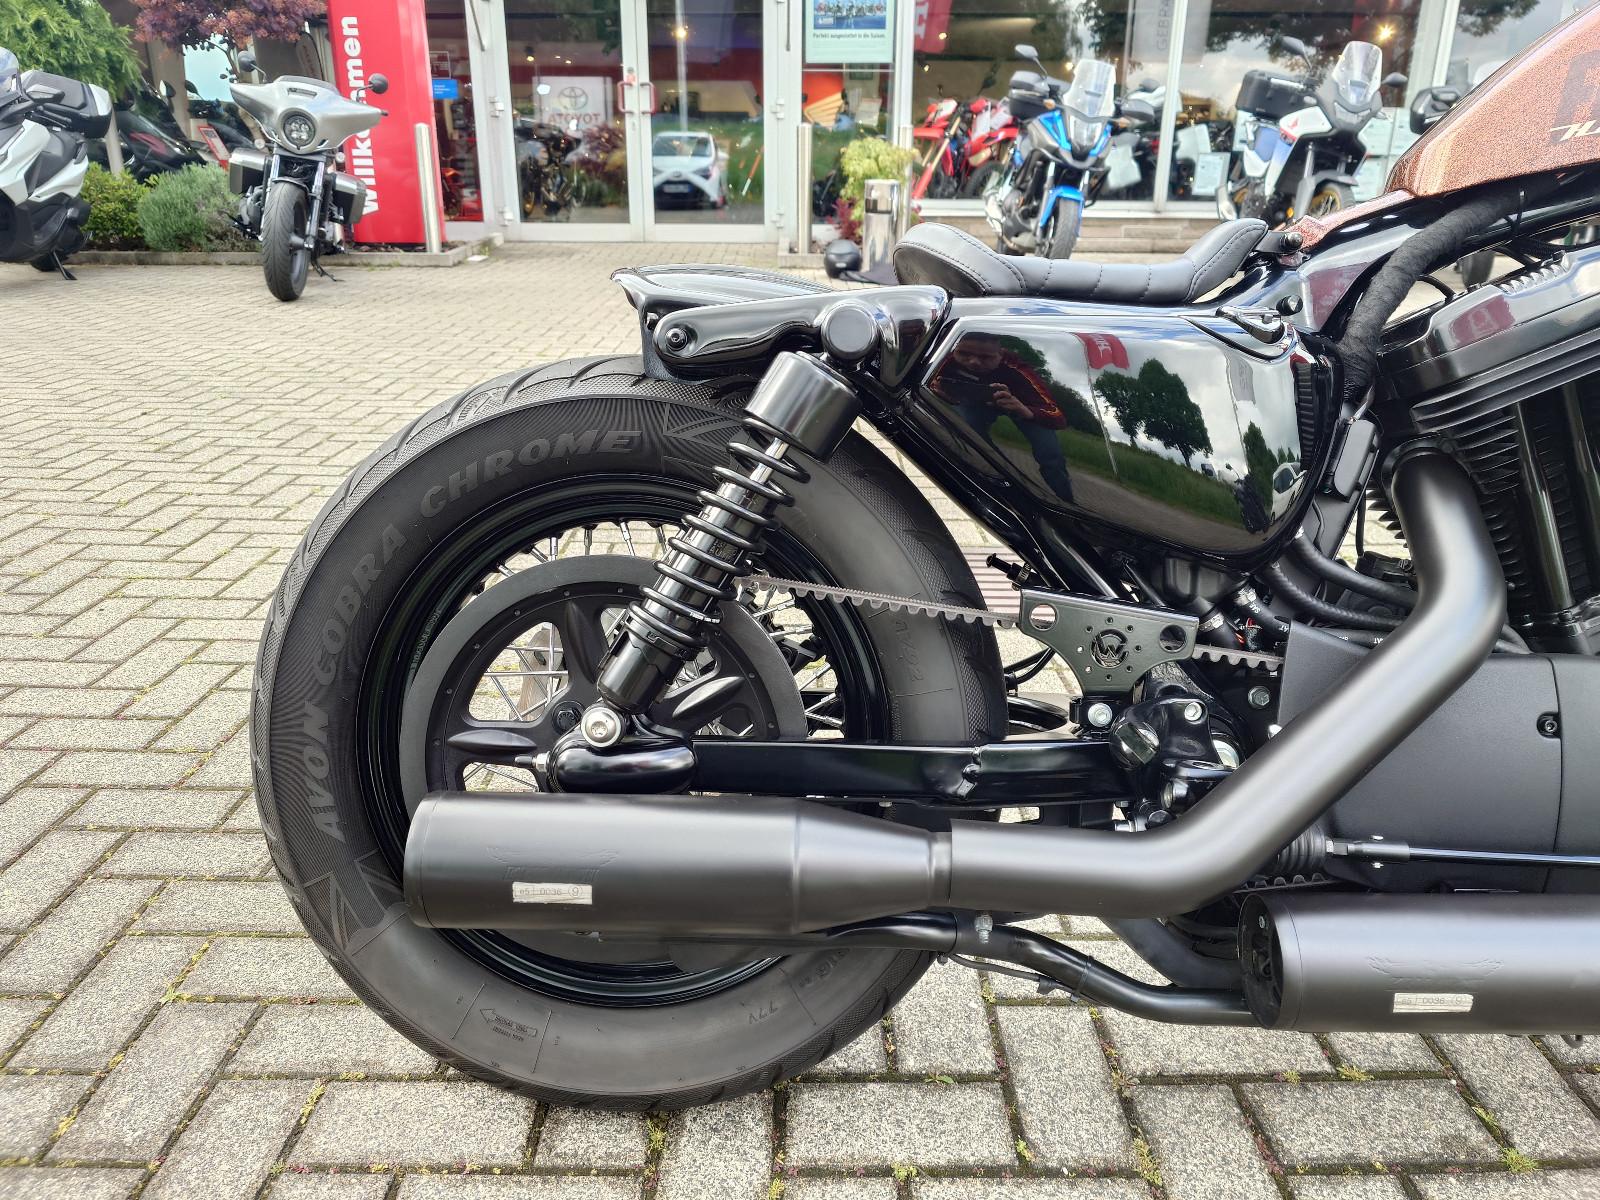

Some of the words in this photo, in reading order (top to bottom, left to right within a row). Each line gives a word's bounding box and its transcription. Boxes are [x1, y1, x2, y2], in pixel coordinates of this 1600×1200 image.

[420, 430, 643, 518] CHROME
[313, 523, 408, 686] COBRA
[303, 700, 347, 843] AVON
